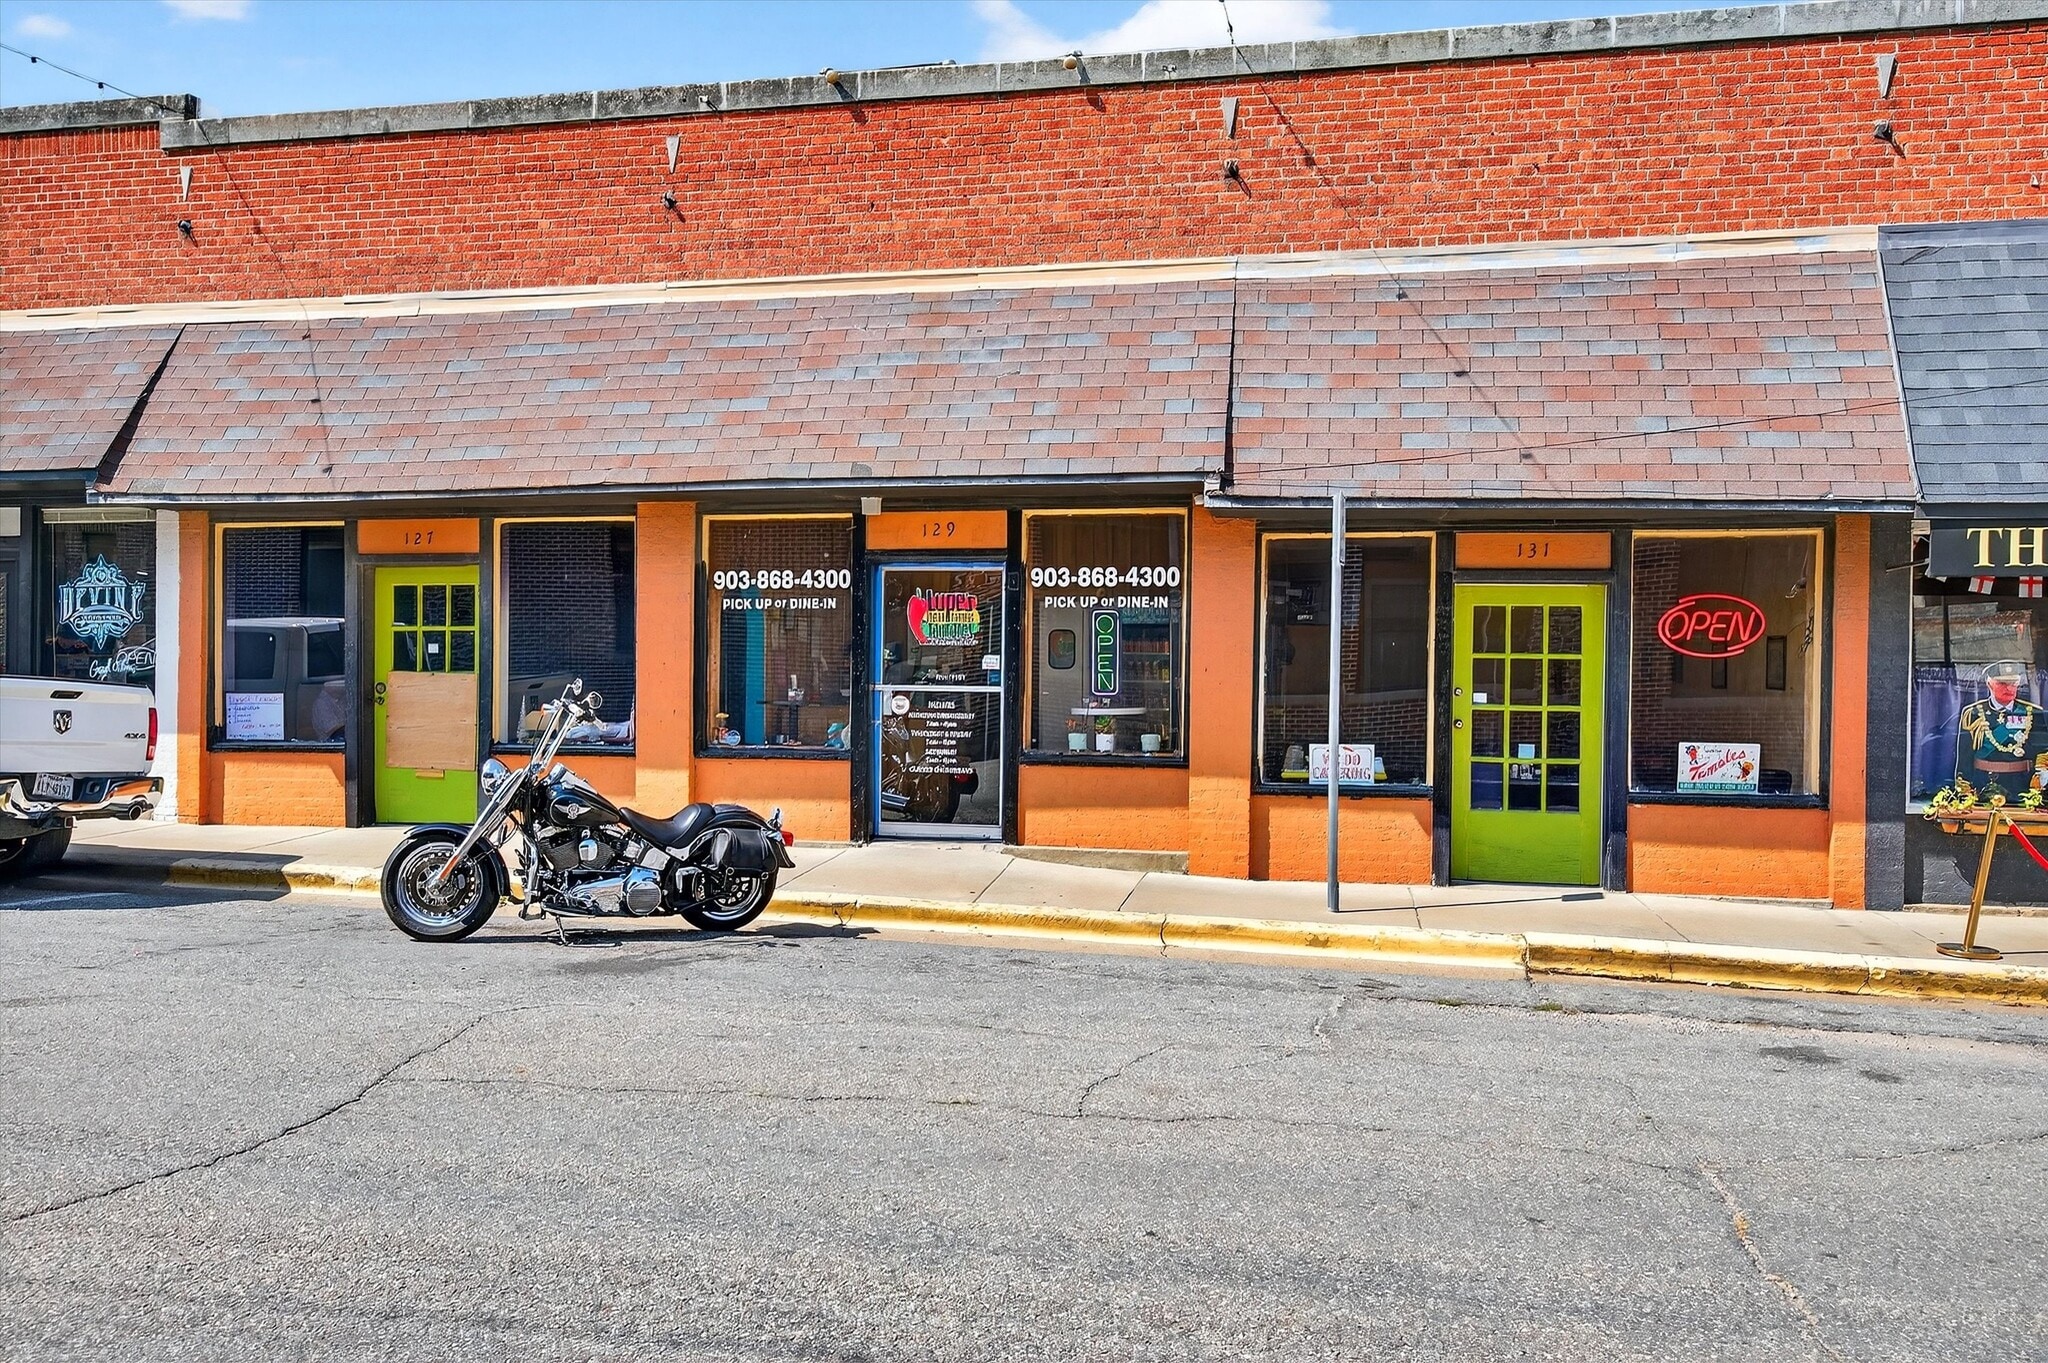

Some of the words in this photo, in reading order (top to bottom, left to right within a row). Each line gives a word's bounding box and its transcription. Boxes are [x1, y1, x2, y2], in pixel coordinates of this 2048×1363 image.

[922, 521, 955, 537] 129
[405, 530, 434, 545] 127
[1518, 542, 1549, 558] 131
[713, 569, 851, 590] 903-868-4300
[1030, 566, 1180, 588] 903-868-4300
[723, 598, 752, 610] PICK
[755, 598, 772, 610] UP
[774, 599, 787, 609] or
[789, 598, 837, 610] DINE-IN
[1044, 596, 1076, 609] PICK
[1080, 596, 1099, 608] UP
[1101, 597, 1115, 608] or
[1117, 596, 1169, 608] DINE-IN
[1664, 611, 1756, 641] OPEN
[1096, 614, 1115, 691] OPEN
